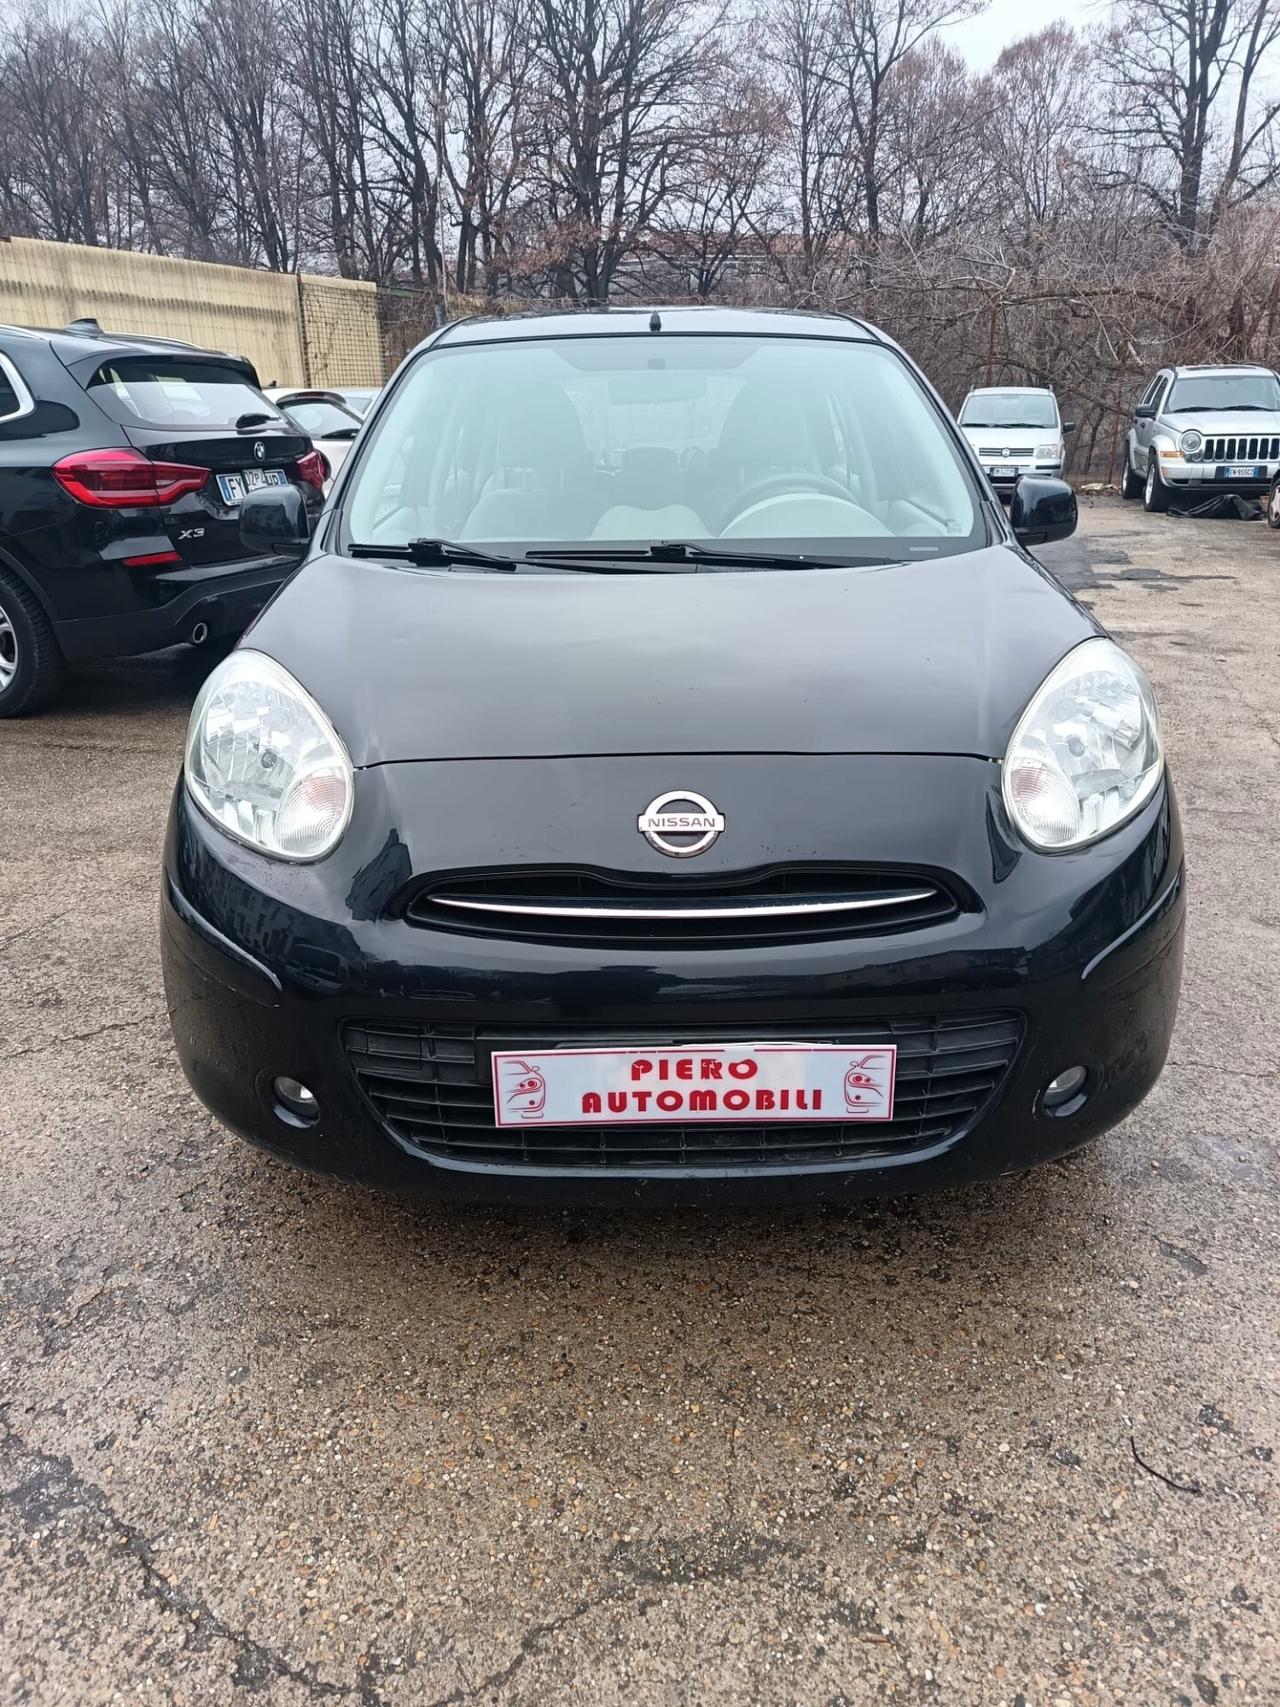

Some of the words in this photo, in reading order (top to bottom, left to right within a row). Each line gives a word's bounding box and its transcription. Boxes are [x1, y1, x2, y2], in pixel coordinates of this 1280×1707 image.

[178, 528, 204, 540] X3
[648, 817, 716, 828] NISSAN
[631, 1058, 757, 1081] PIERO
[582, 1089, 822, 1113] AUTOMOBILI
